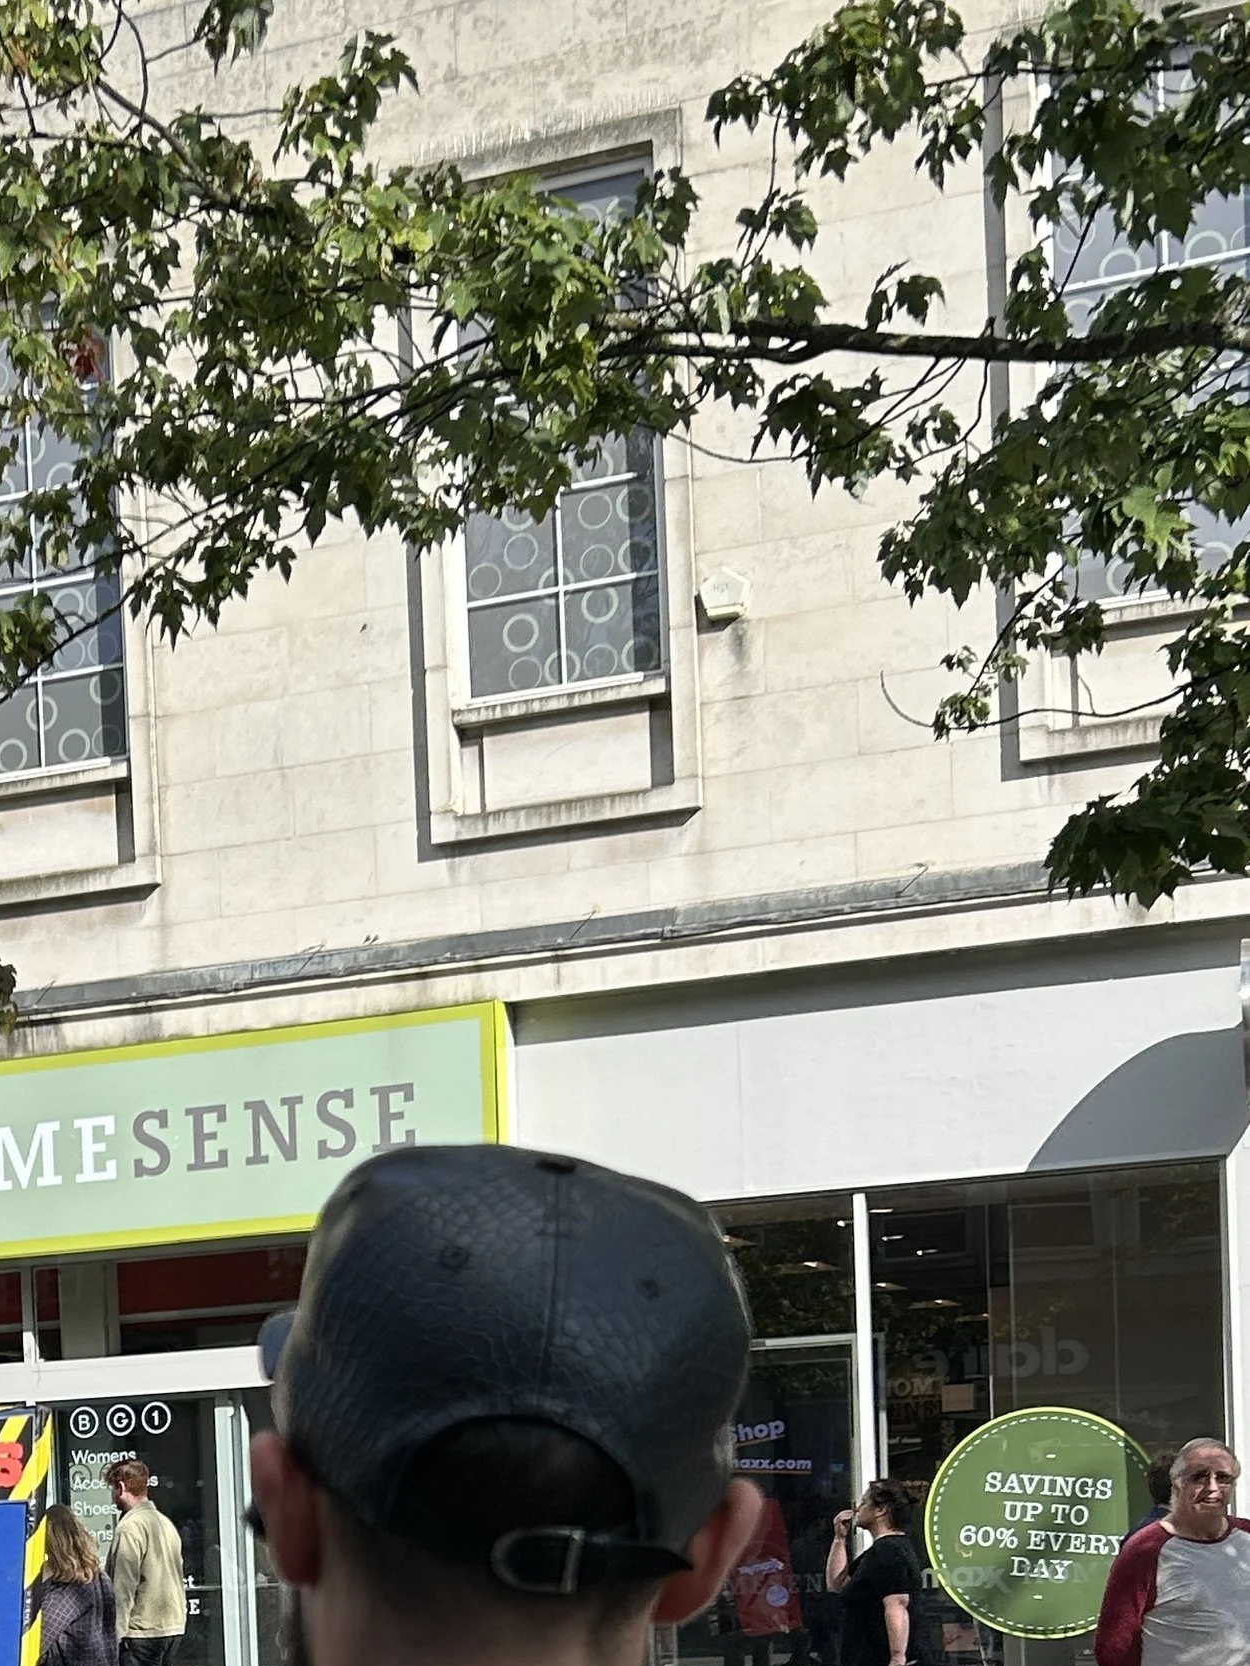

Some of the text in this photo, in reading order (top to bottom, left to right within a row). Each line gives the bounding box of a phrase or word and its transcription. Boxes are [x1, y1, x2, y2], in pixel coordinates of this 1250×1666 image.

[77, 1414, 91, 1431] B
[113, 1412, 128, 1429] G
[71, 1450, 137, 1465] Womens
[984, 1471, 1112, 1500] SAVINGS
[73, 1501, 119, 1516] Shoes
[1003, 1501, 1089, 1526] UP TO
[959, 1525, 1124, 1556] 60% EVERY
[1010, 1556, 1073, 1581] DAY
